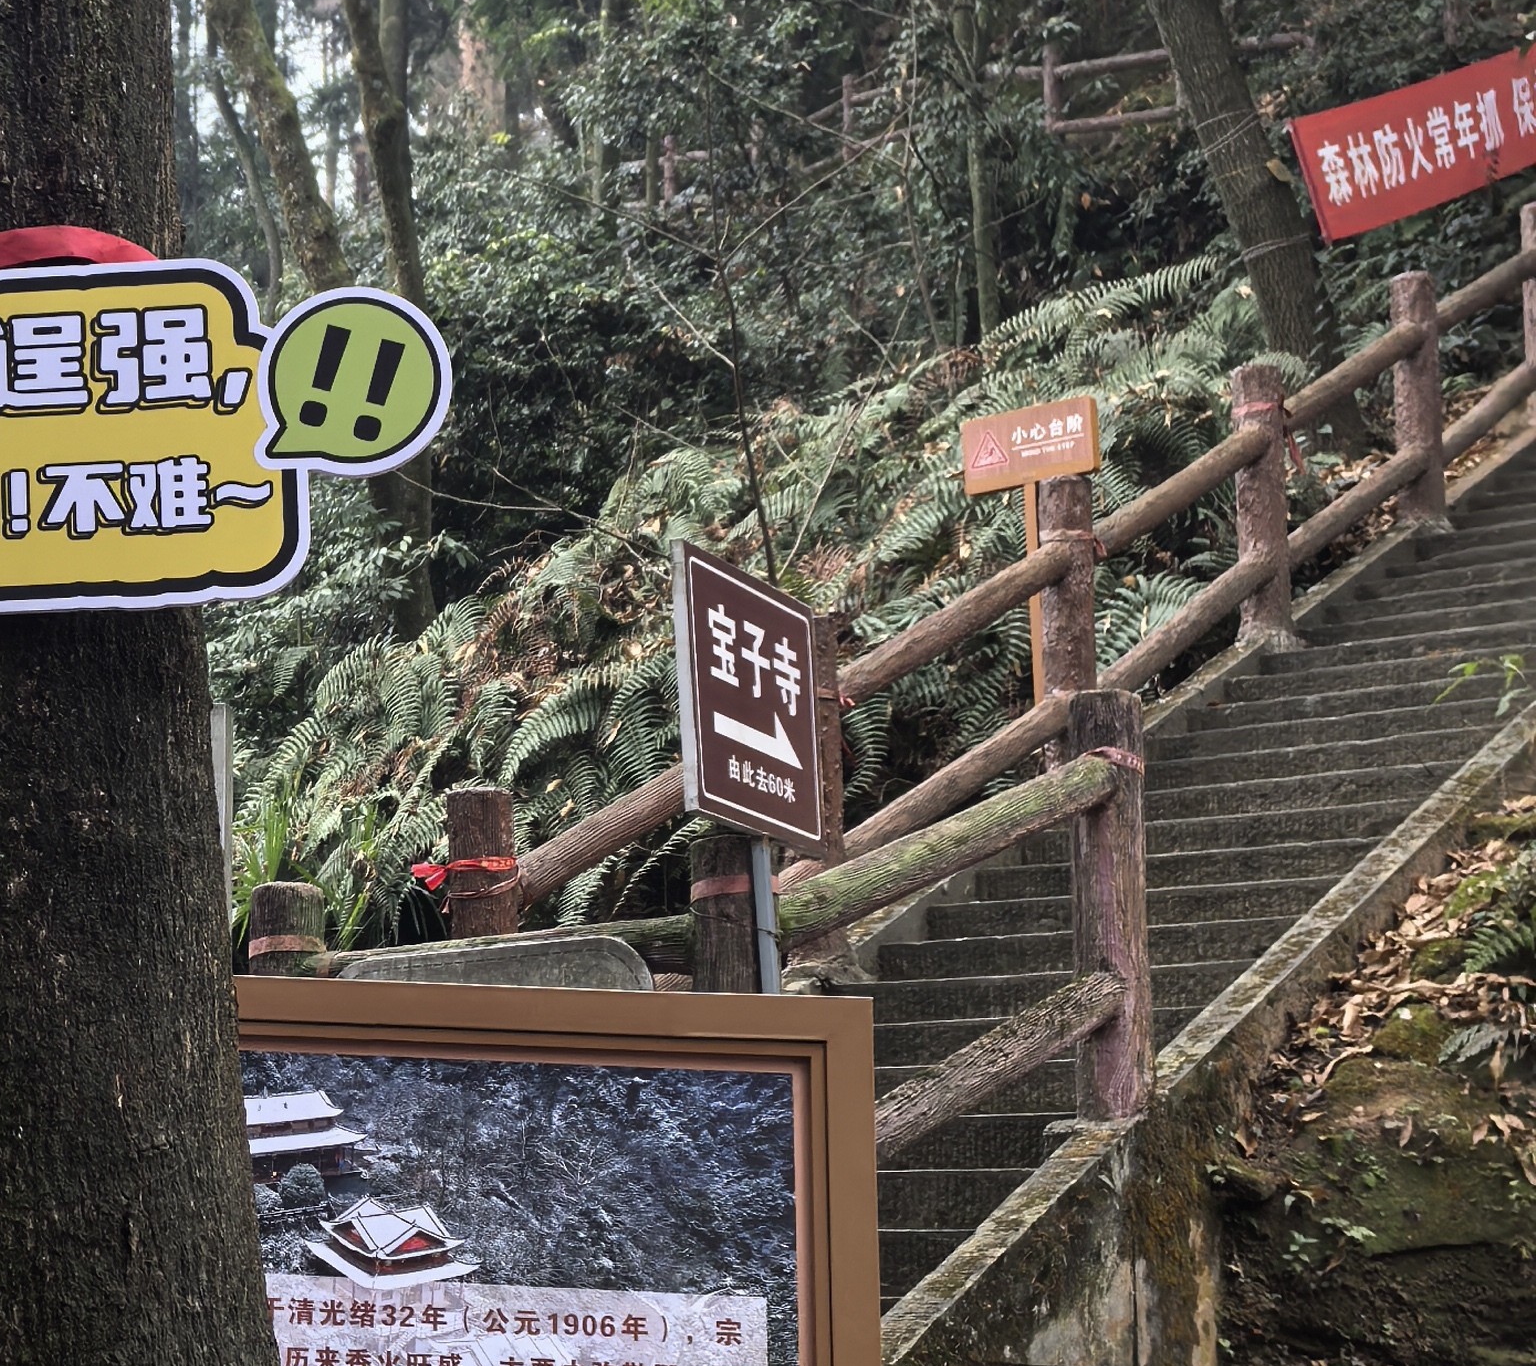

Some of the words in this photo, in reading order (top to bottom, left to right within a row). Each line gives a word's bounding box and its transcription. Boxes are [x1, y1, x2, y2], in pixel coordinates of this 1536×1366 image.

[1317, 88, 1504, 206] 森林防火常年抓
[1011, 413, 1084, 445] 小心台阶
[707, 604, 802, 716] 宝子寺
[727, 754, 796, 804] 由此去60米
